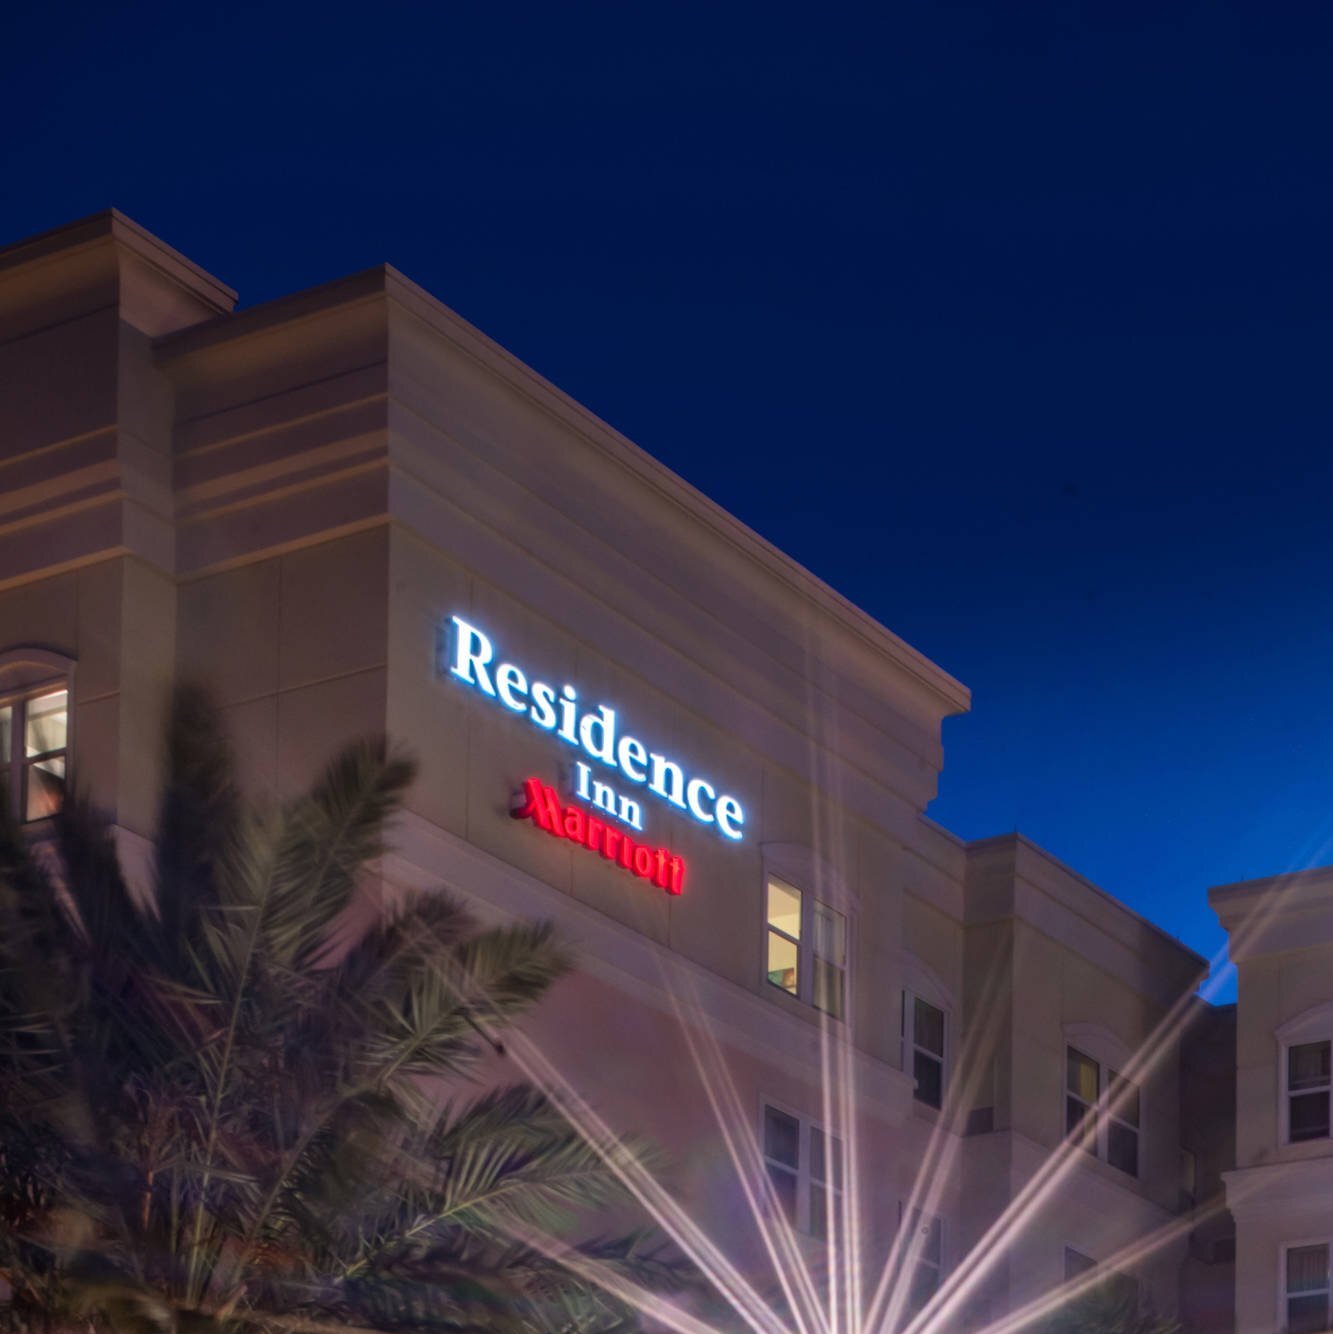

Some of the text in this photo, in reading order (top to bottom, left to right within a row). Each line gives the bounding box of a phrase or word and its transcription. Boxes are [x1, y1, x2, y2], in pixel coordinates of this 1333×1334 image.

[450, 613, 745, 841] Residence
[511, 776, 686, 896] Marriott
[574, 760, 644, 832] Inn
